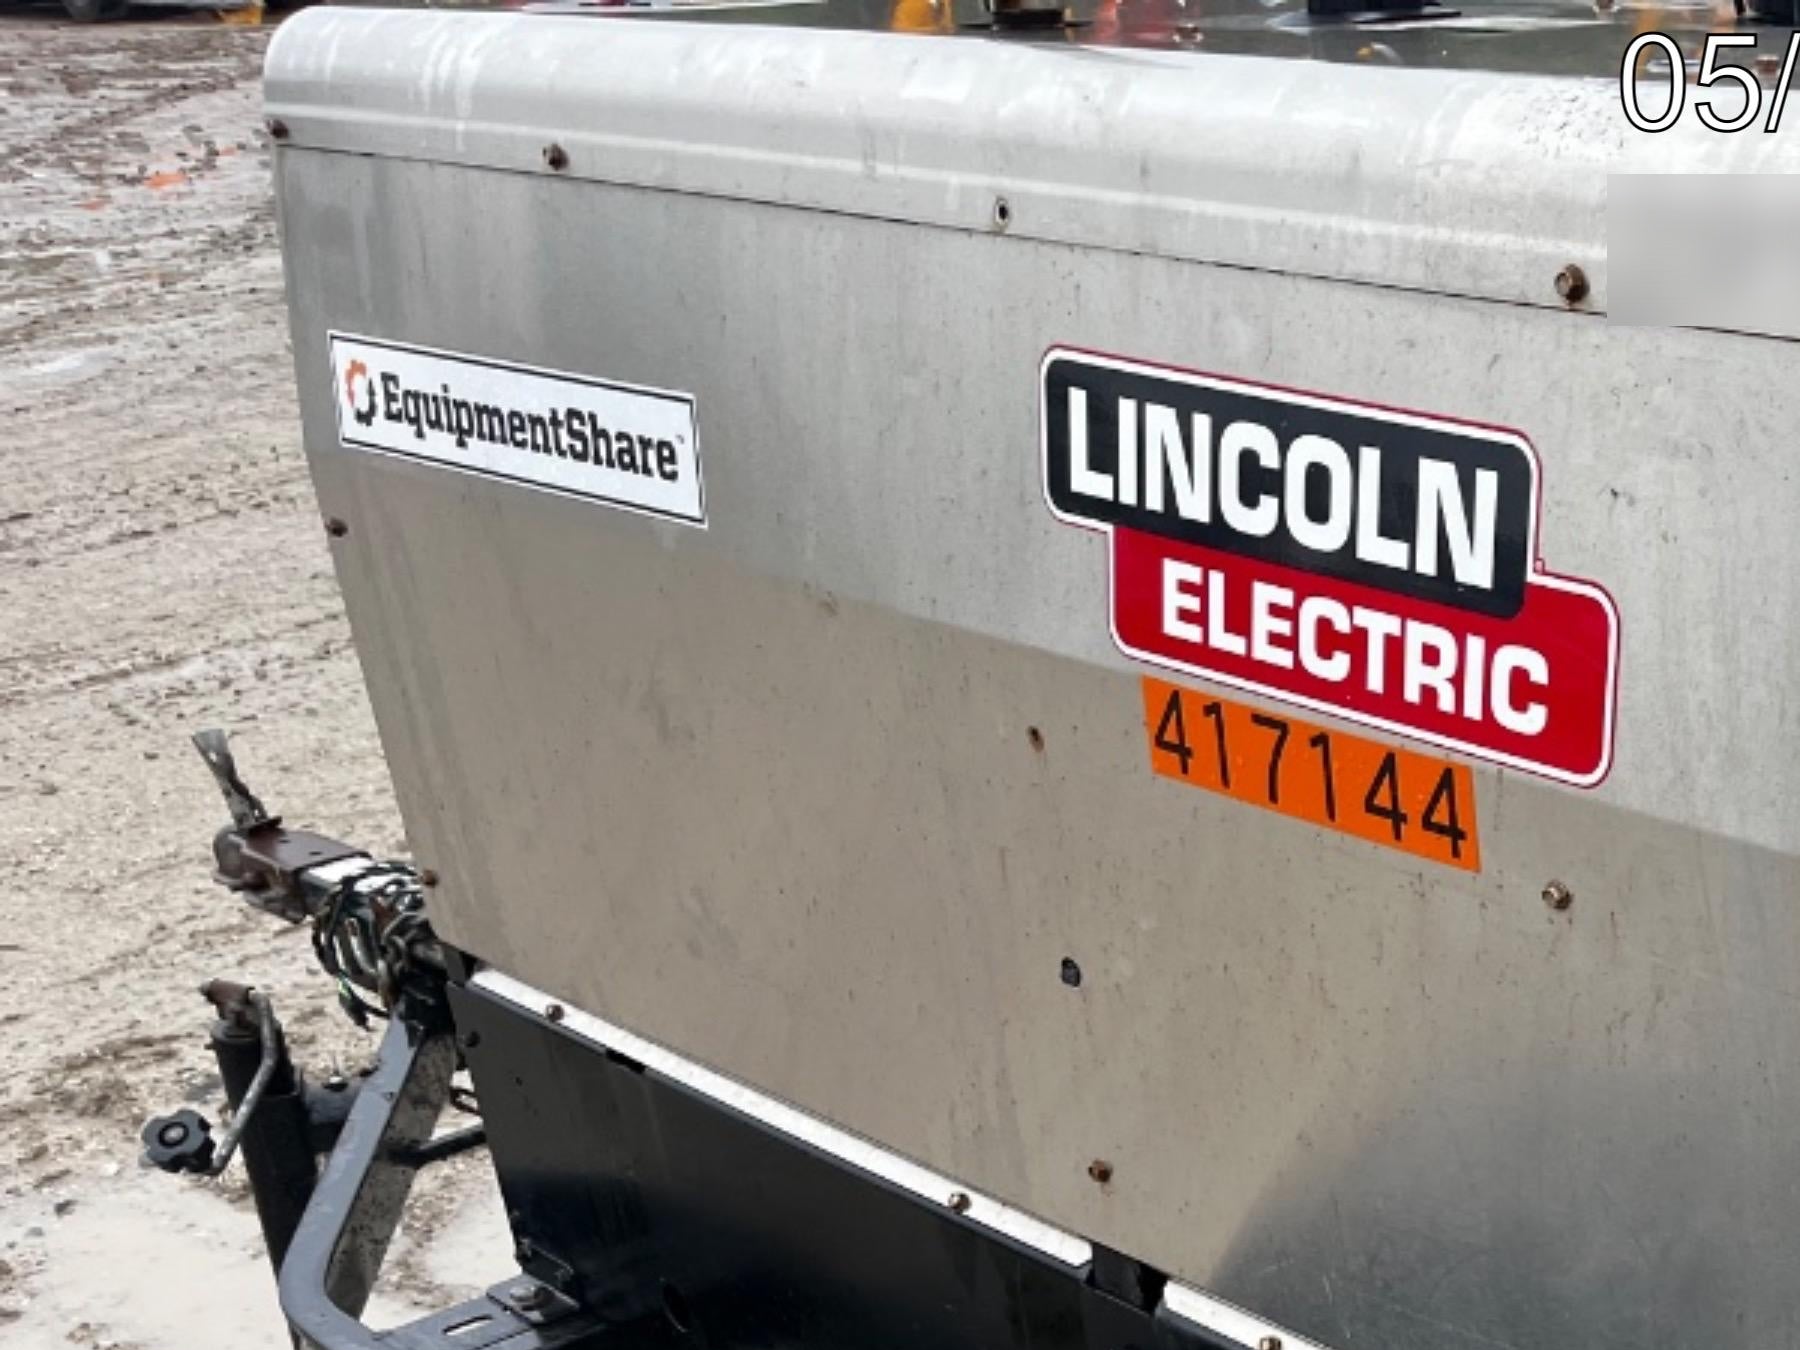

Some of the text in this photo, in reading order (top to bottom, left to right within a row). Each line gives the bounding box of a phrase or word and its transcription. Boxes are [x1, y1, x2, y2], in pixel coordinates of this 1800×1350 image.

[380, 371, 680, 482] EquipmentShare
[1067, 386, 1499, 590] LINCOLN
[1160, 557, 1549, 736] ELECTRIC
[1154, 689, 1467, 859] 417144
